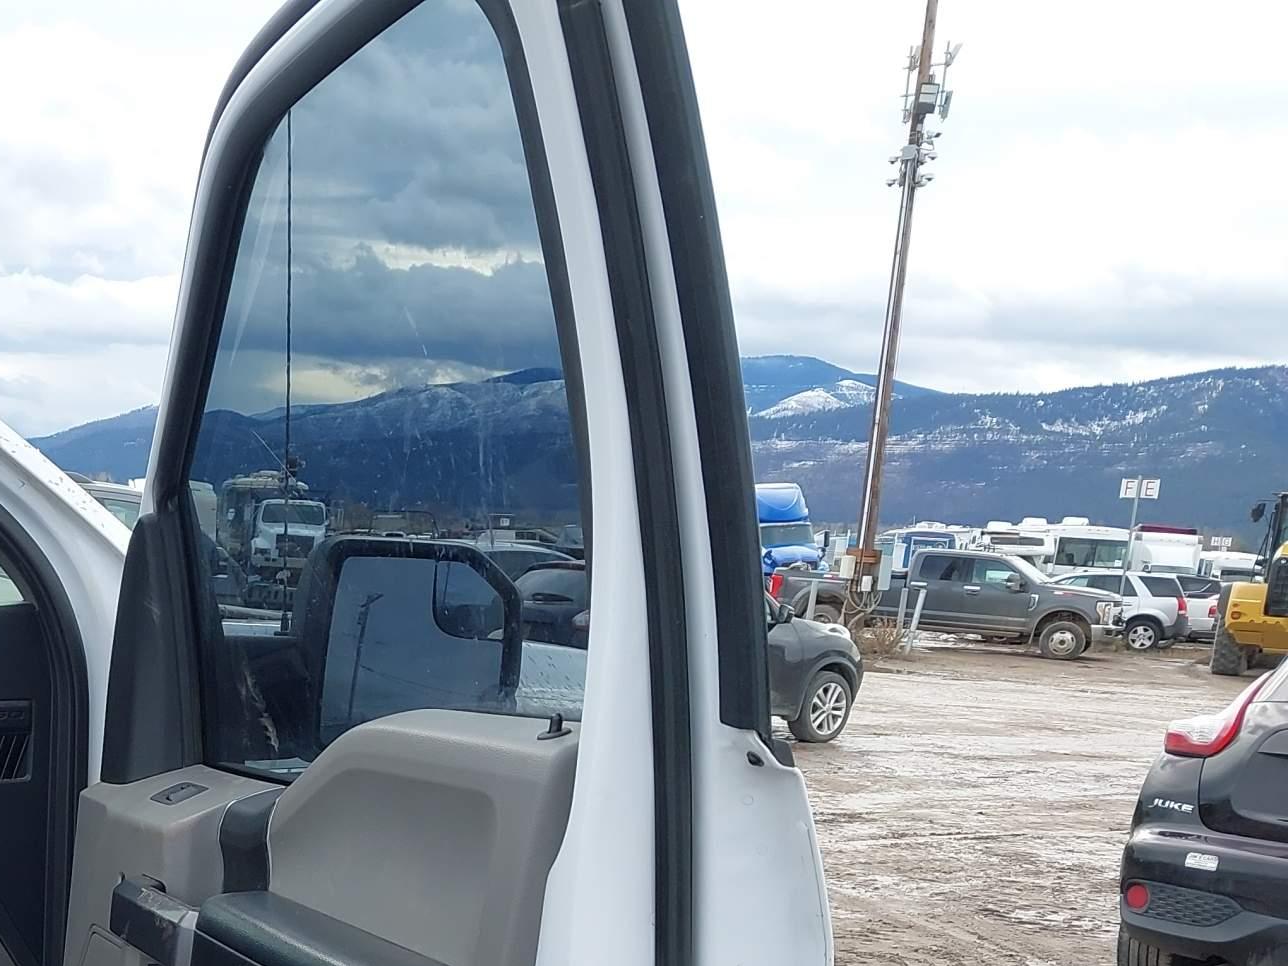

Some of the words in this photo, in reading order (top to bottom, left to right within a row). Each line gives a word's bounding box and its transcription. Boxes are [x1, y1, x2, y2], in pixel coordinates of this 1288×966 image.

[1124, 480, 1136, 497] F
[1145, 480, 1156, 497] E
[1146, 798, 1195, 814] JUKE
